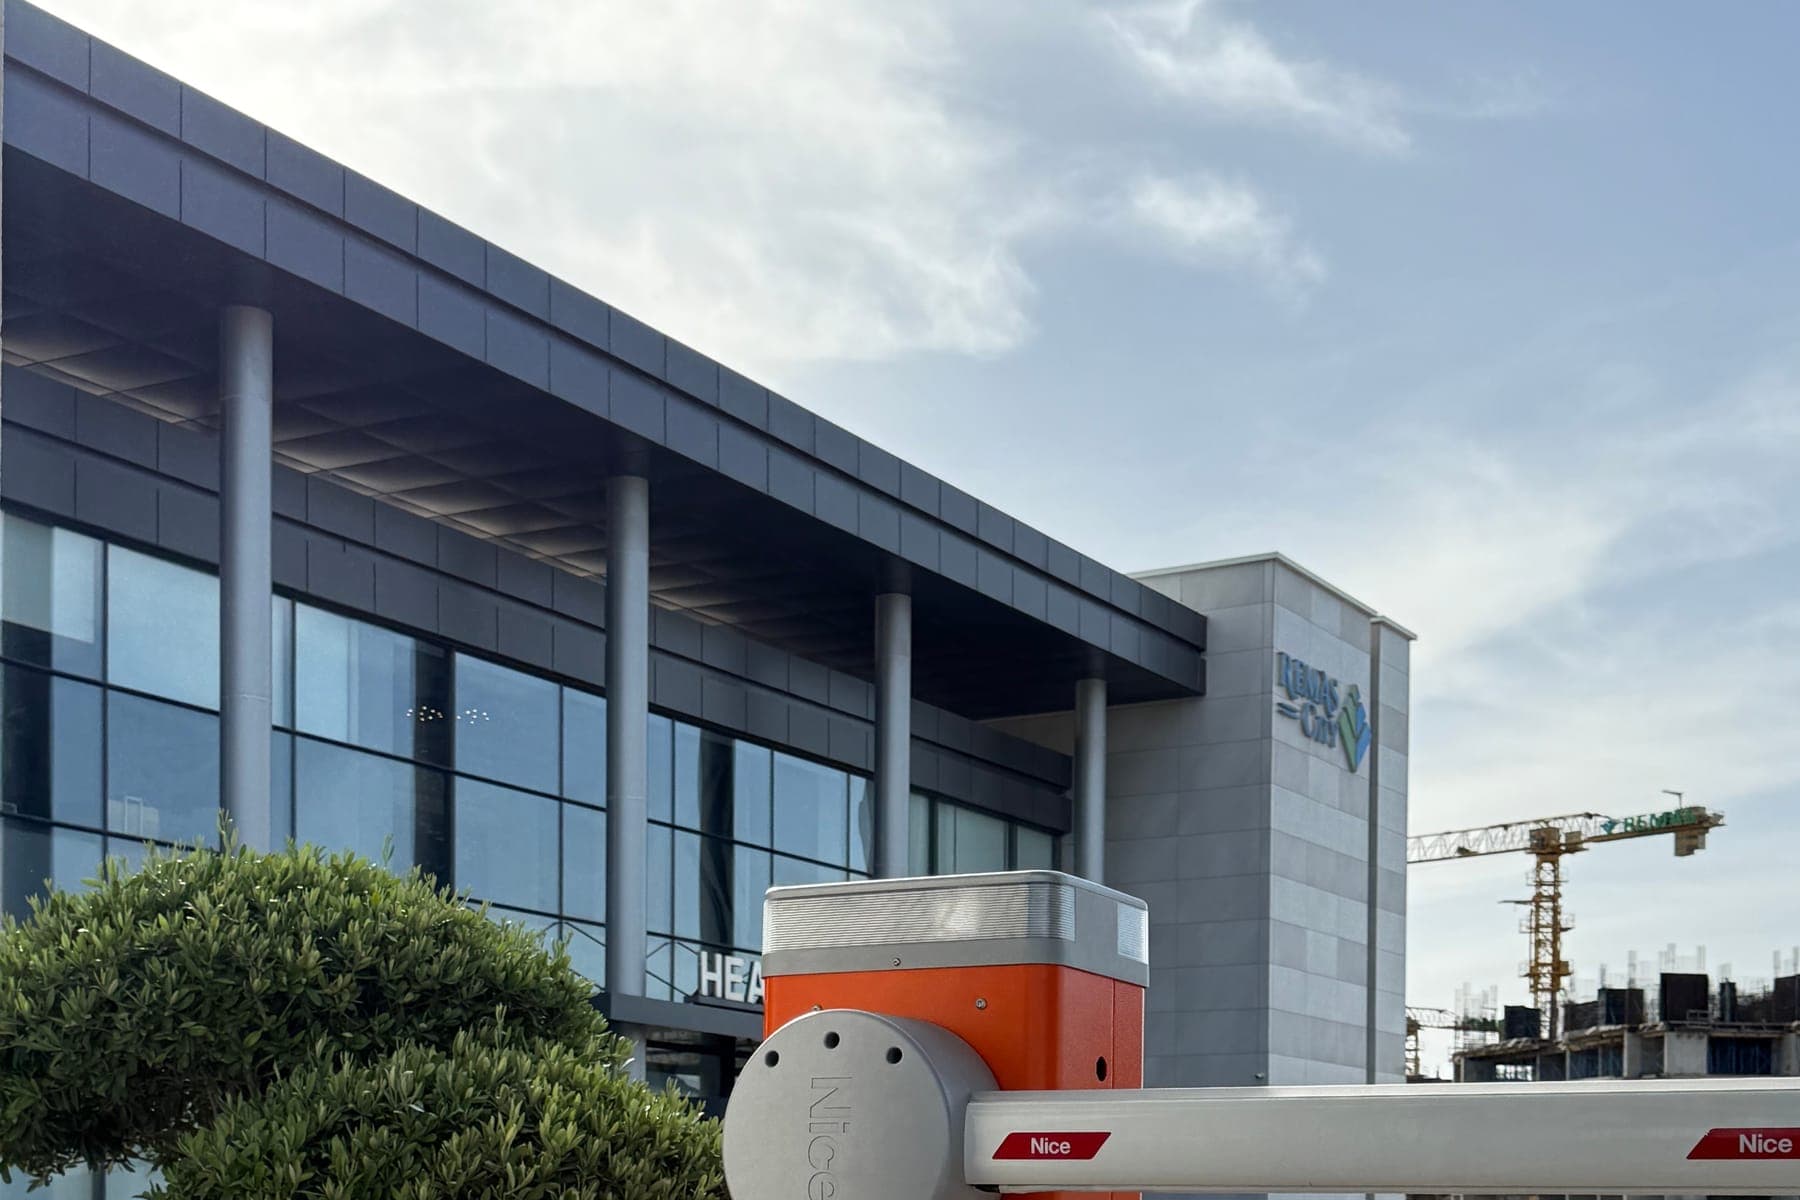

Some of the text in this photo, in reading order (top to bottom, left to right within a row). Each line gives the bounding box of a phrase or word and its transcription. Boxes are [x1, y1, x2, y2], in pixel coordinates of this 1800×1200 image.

[1623, 807, 1697, 832] REM
[1030, 1137, 1071, 1154] Nice
[1739, 1133, 1793, 1153] Nice
